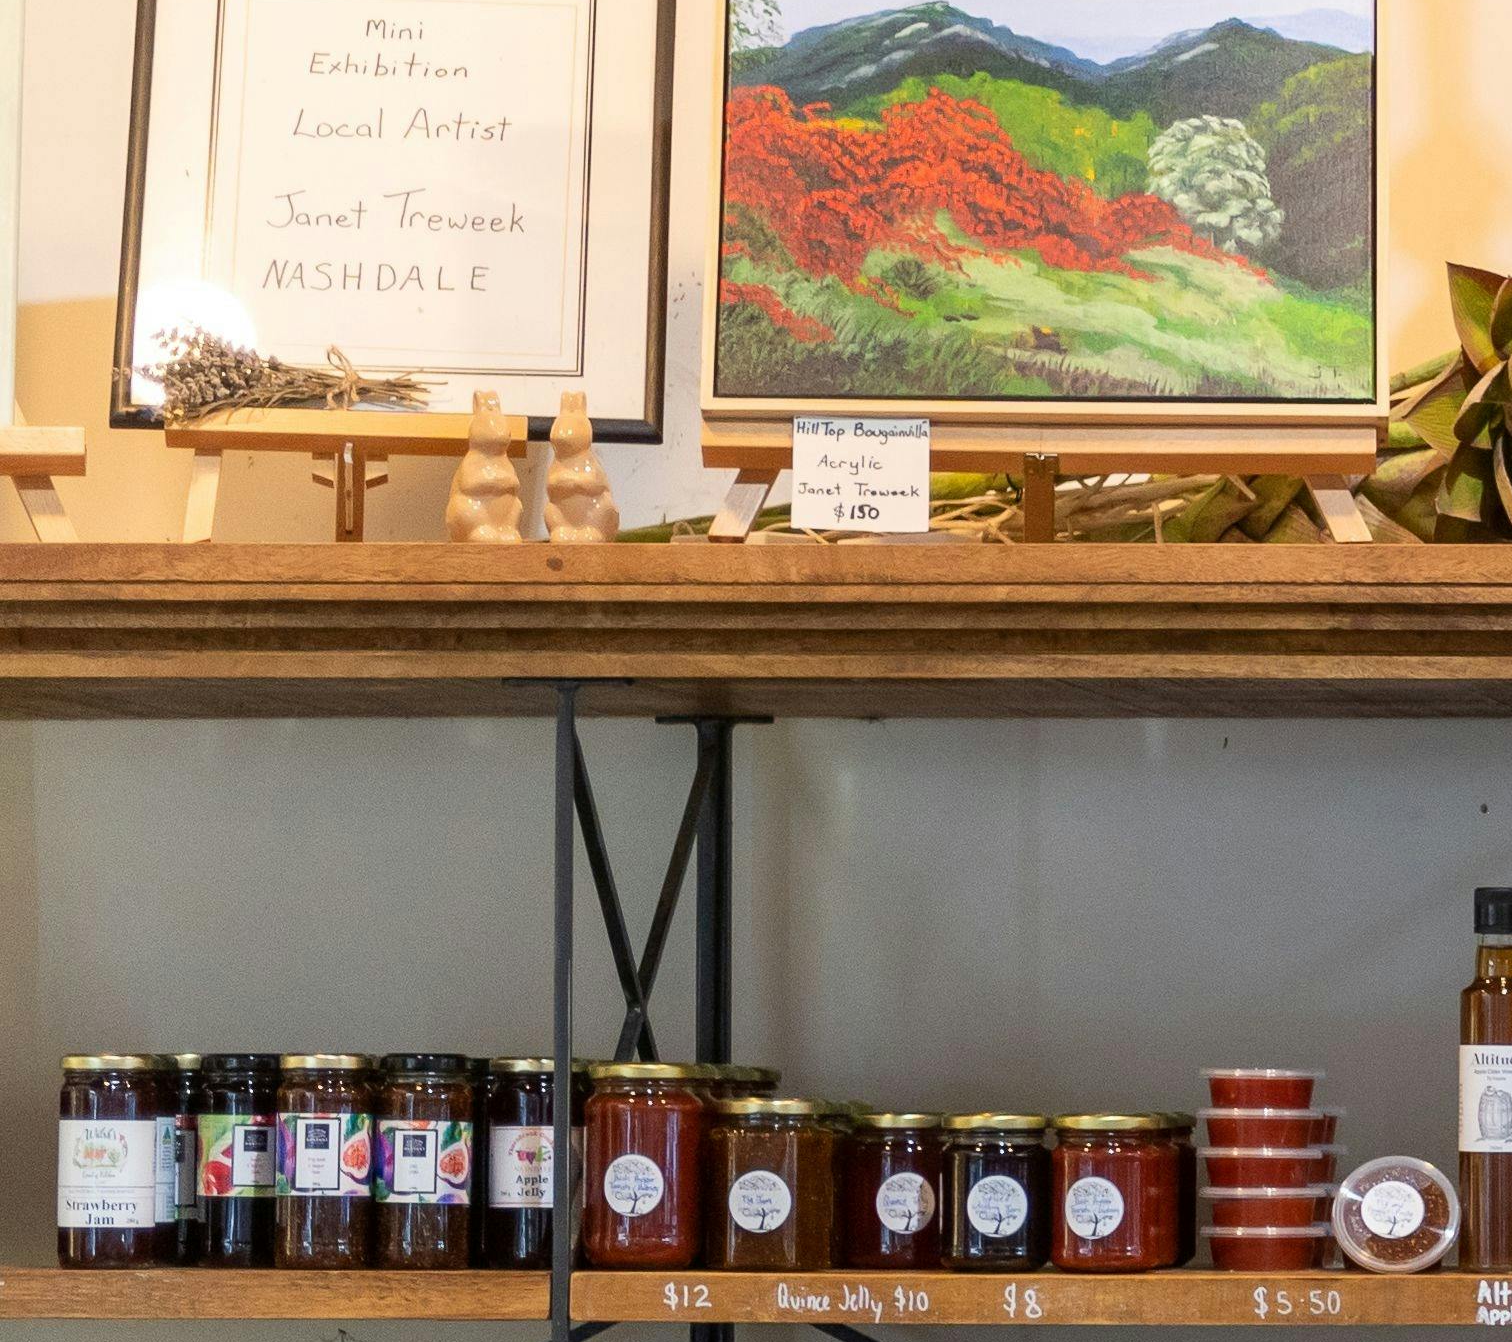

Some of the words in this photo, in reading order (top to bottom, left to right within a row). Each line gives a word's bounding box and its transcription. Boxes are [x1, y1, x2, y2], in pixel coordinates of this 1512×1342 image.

[366, 18, 424, 41] Mini
[310, 52, 469, 78] Exhibition
[293, 110, 382, 139] Local
[404, 108, 512, 141] Artist
[267, 190, 367, 230] Janet
[382, 188, 525, 234] Treweek
[262, 261, 490, 291] NASHDALE
[818, 455, 883, 475] Acrylic
[799, 483, 841, 495] Janet
[855, 483, 919, 496] Treweek
[515, 1174, 549, 1185] Apple
[66, 1199, 138, 1214] Strawberry
[84, 1214, 115, 1227] Jam
[663, 1284, 712, 1310] $12
[777, 1283, 830, 1312] Quince
[840, 1283, 882, 1322] Jelly
[894, 1285, 929, 1314] $10
